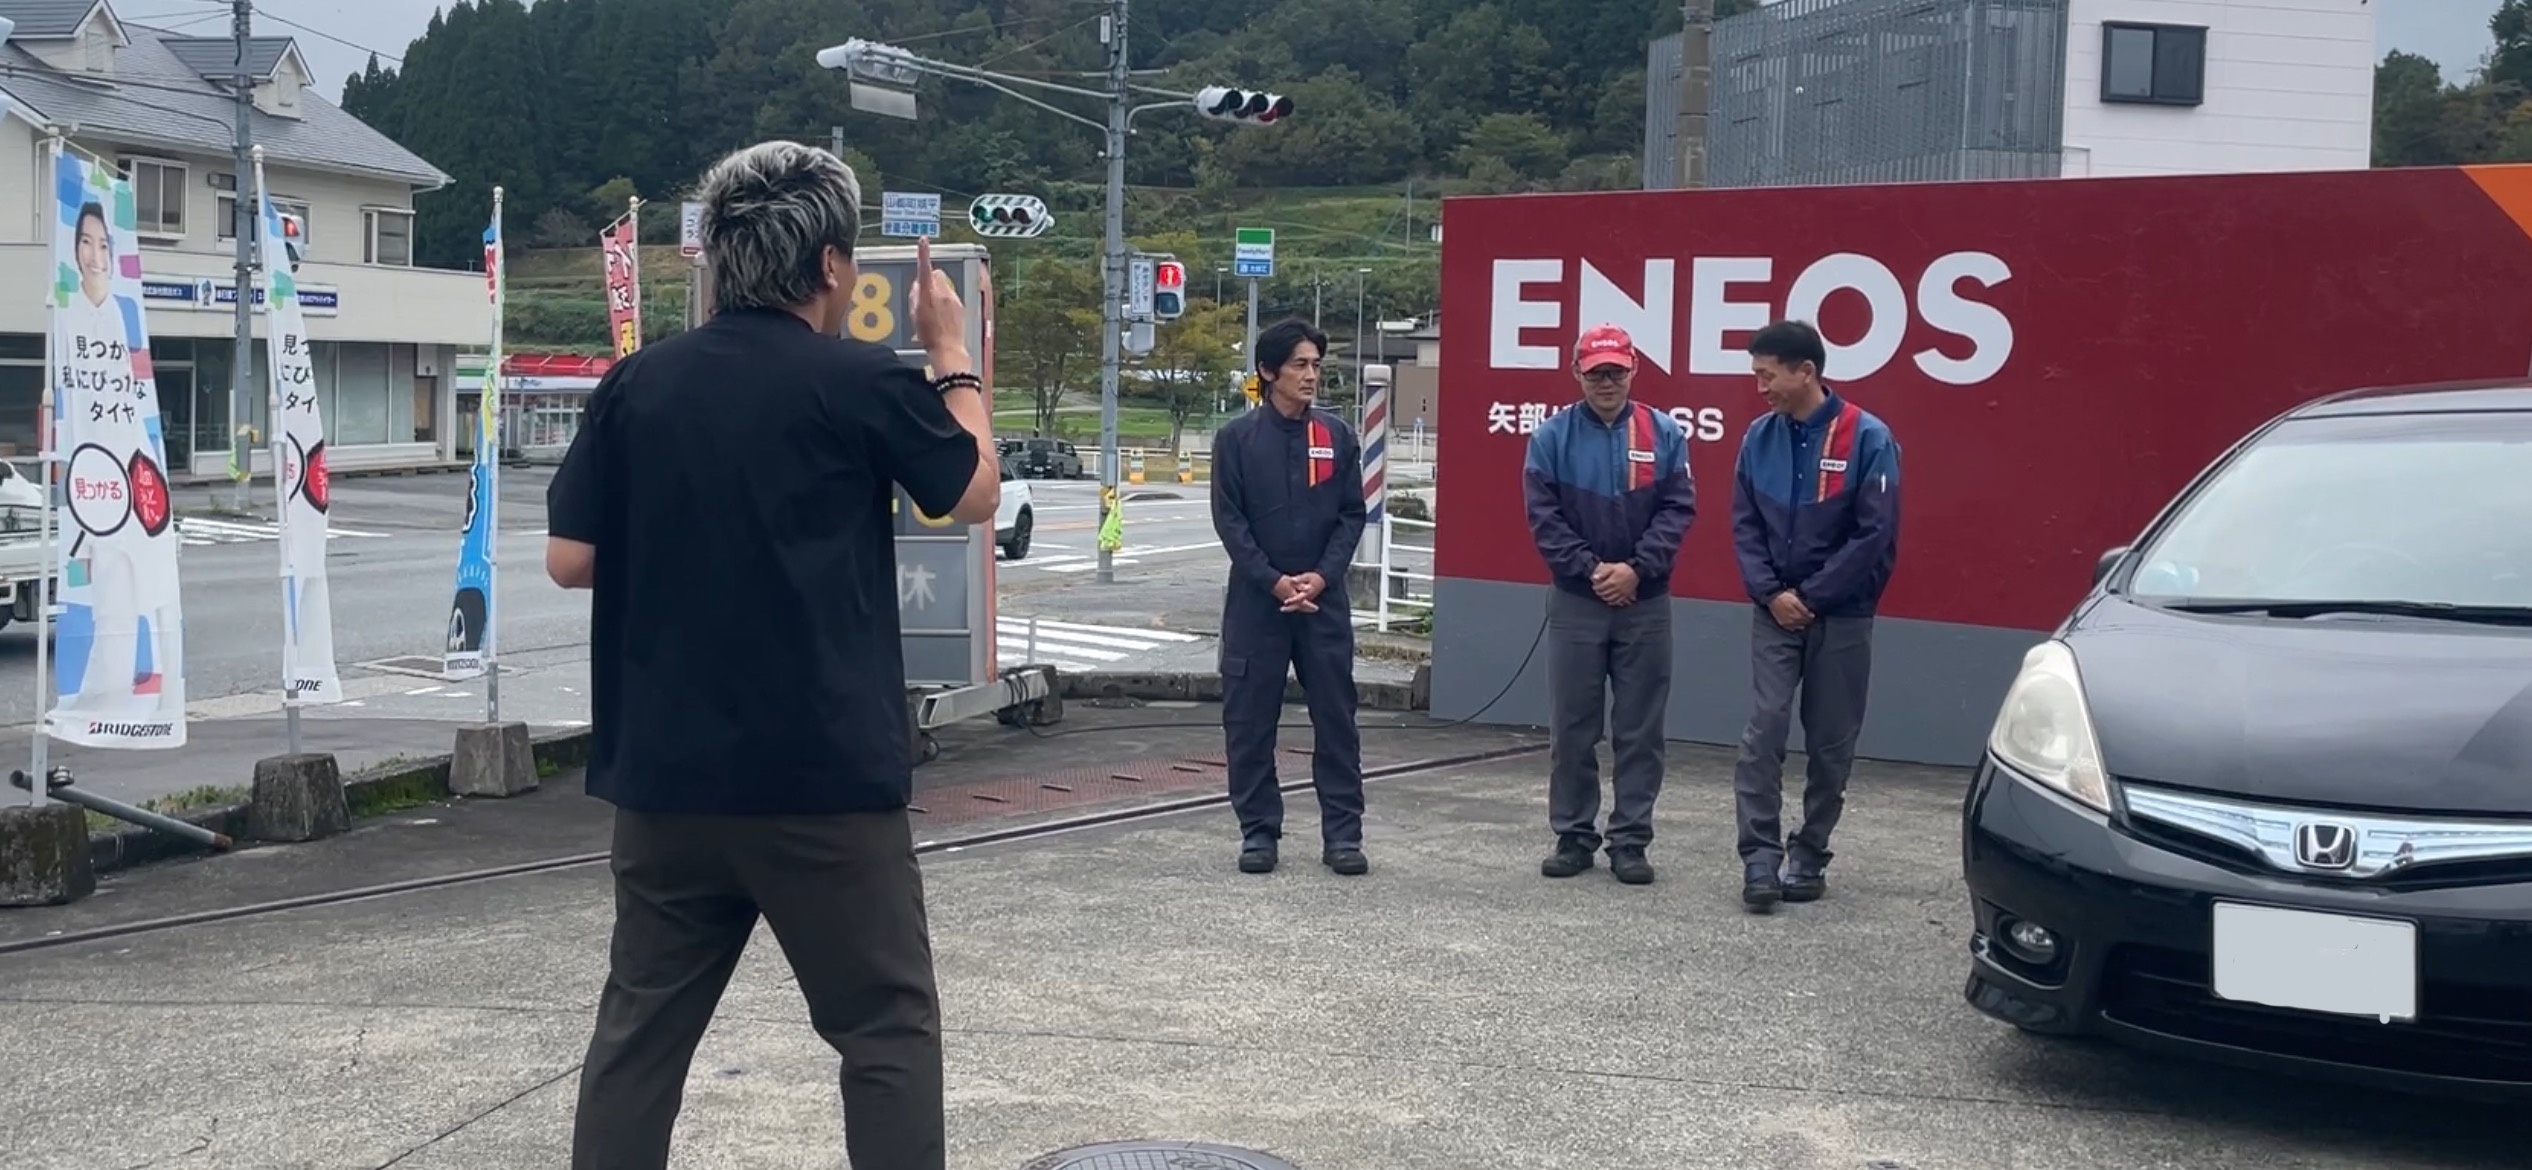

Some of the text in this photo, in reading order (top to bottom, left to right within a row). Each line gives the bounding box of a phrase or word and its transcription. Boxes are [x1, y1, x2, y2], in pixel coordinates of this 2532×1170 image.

[1490, 251, 2014, 385] ENEOS
[90, 401, 134, 424] タイヤ
[286, 392, 315, 414] タイ
[75, 477, 122, 500] 見つかる
[295, 679, 323, 691] ONE
[89, 722, 173, 738] BRIDGESTONE
